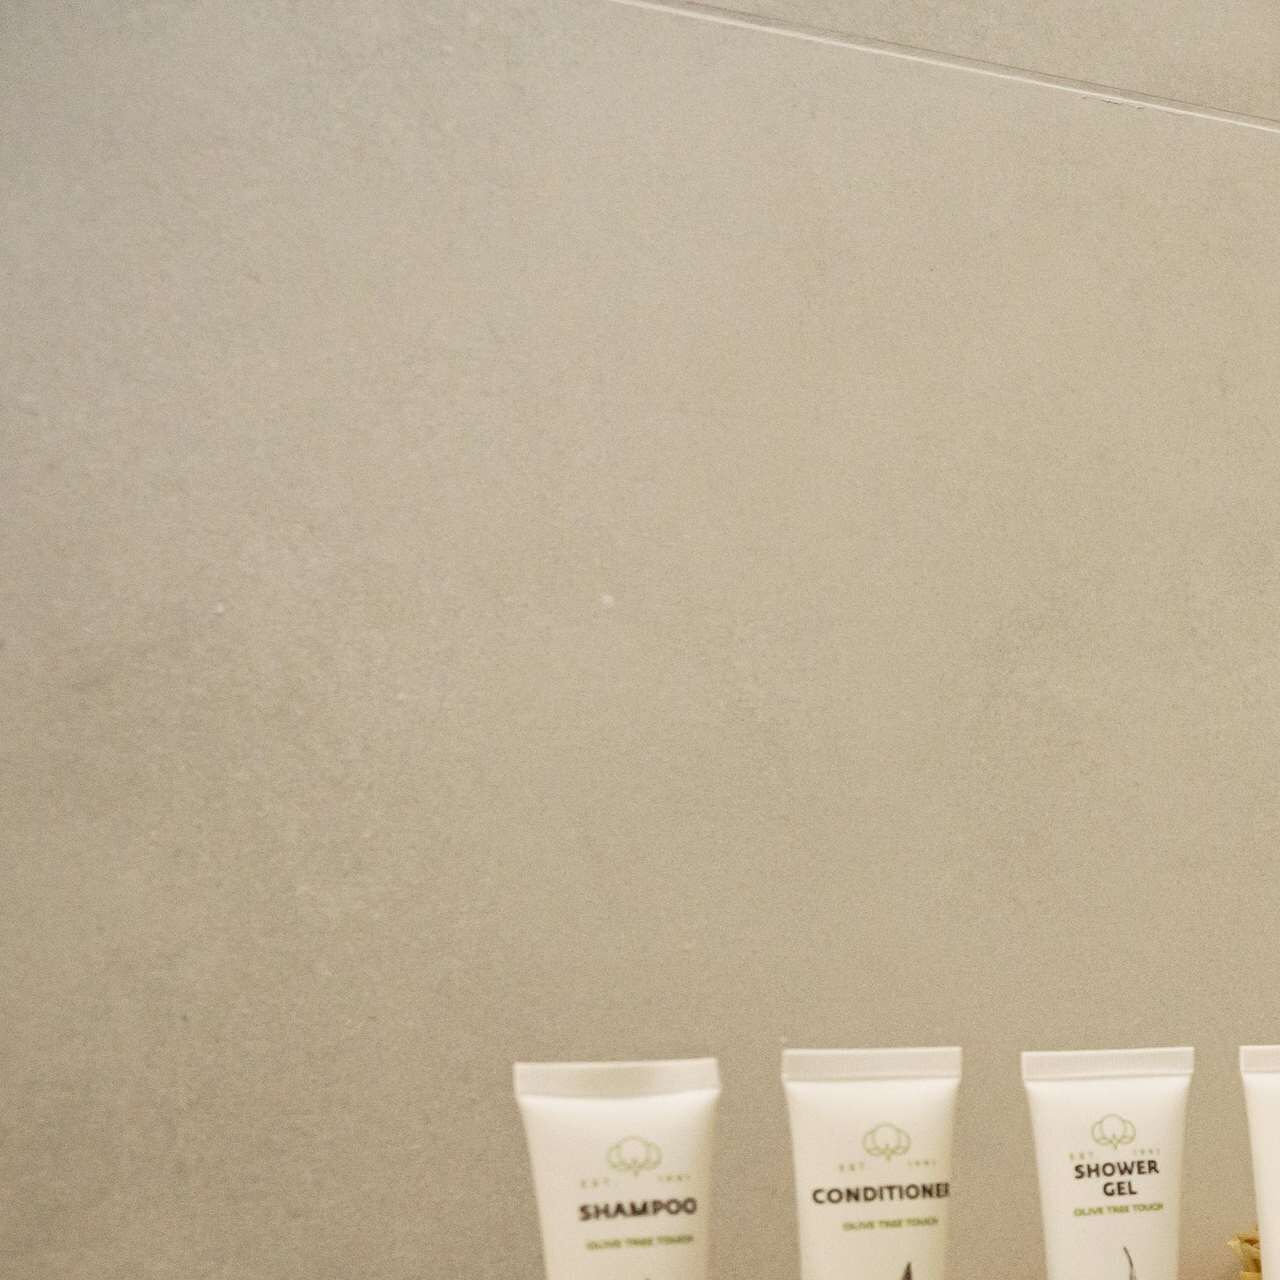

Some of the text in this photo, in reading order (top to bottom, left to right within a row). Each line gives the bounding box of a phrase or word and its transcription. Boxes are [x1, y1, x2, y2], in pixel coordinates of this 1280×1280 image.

[1074, 1159, 1160, 1179] SHOWER
[1102, 1180, 1138, 1197] GEL
[578, 1197, 698, 1222] SHAMPOO
